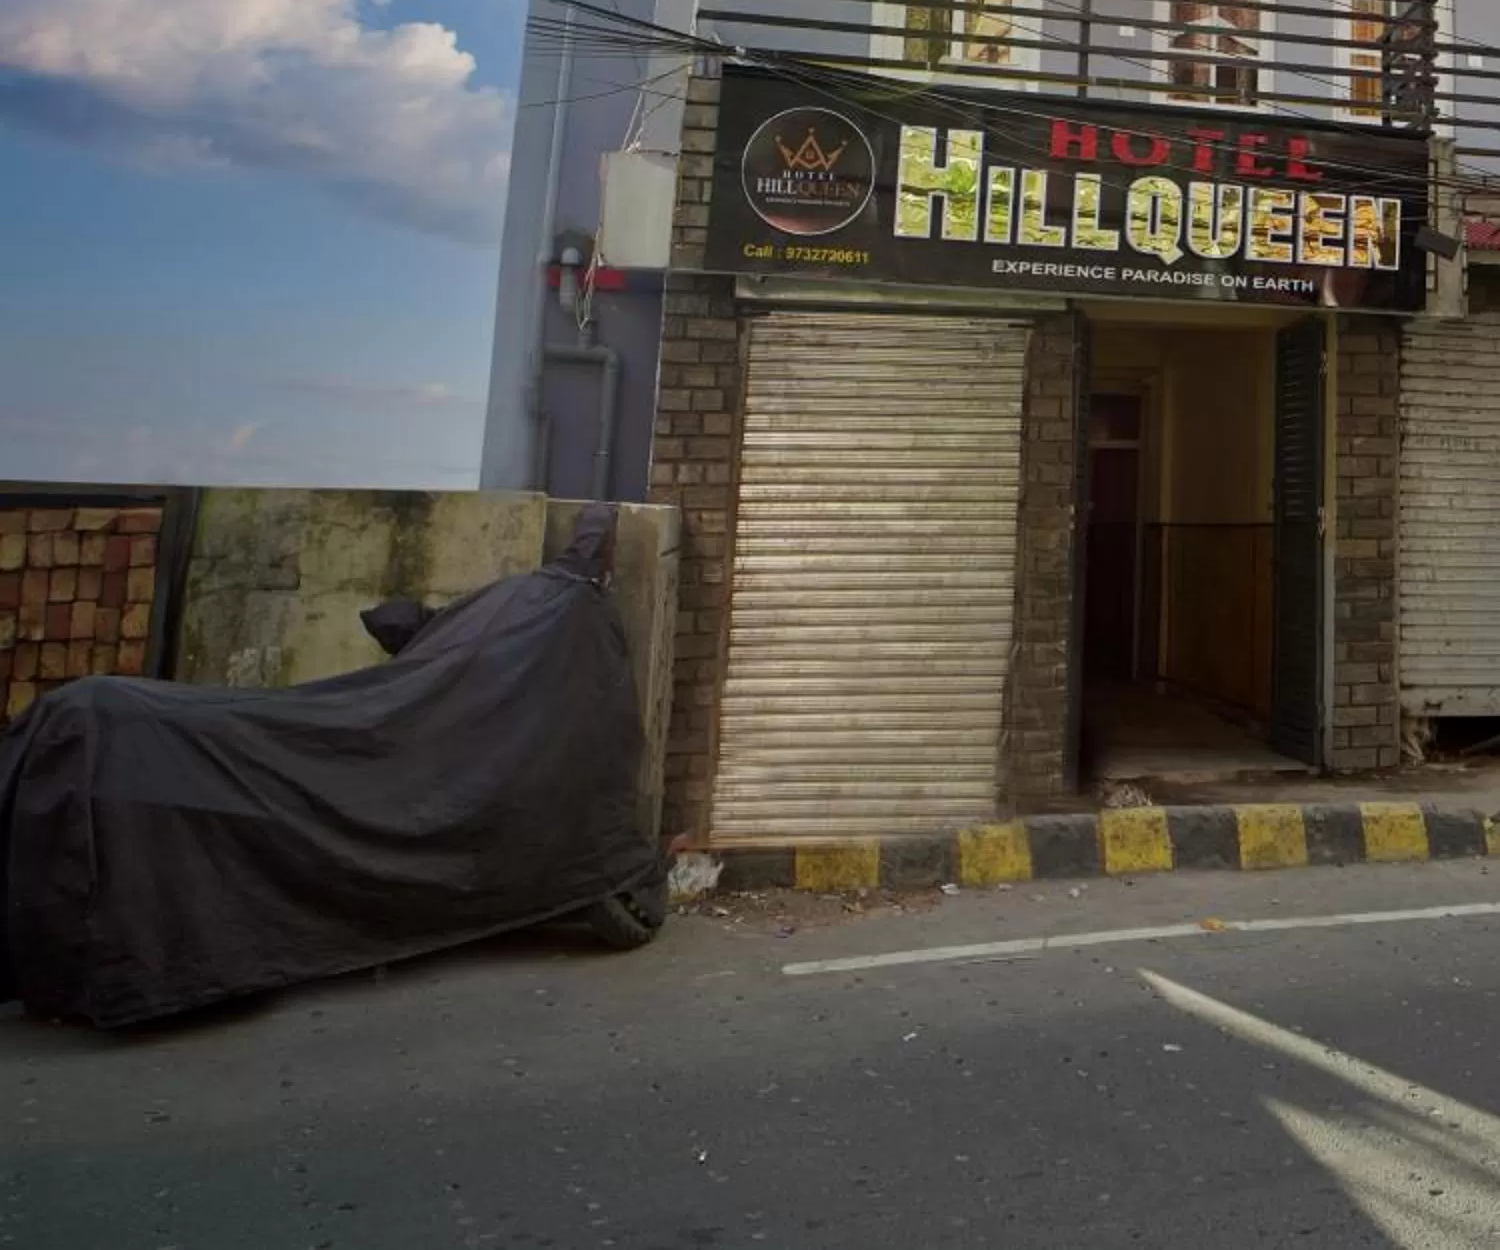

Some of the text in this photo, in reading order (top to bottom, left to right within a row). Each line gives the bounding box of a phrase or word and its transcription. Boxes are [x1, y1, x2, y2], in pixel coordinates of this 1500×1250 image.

[1049, 119, 1323, 181] HOTEL
[744, 244, 774, 257] Call
[992, 259, 1314, 292] EXPERIENCE PARADISE ON EARTH
